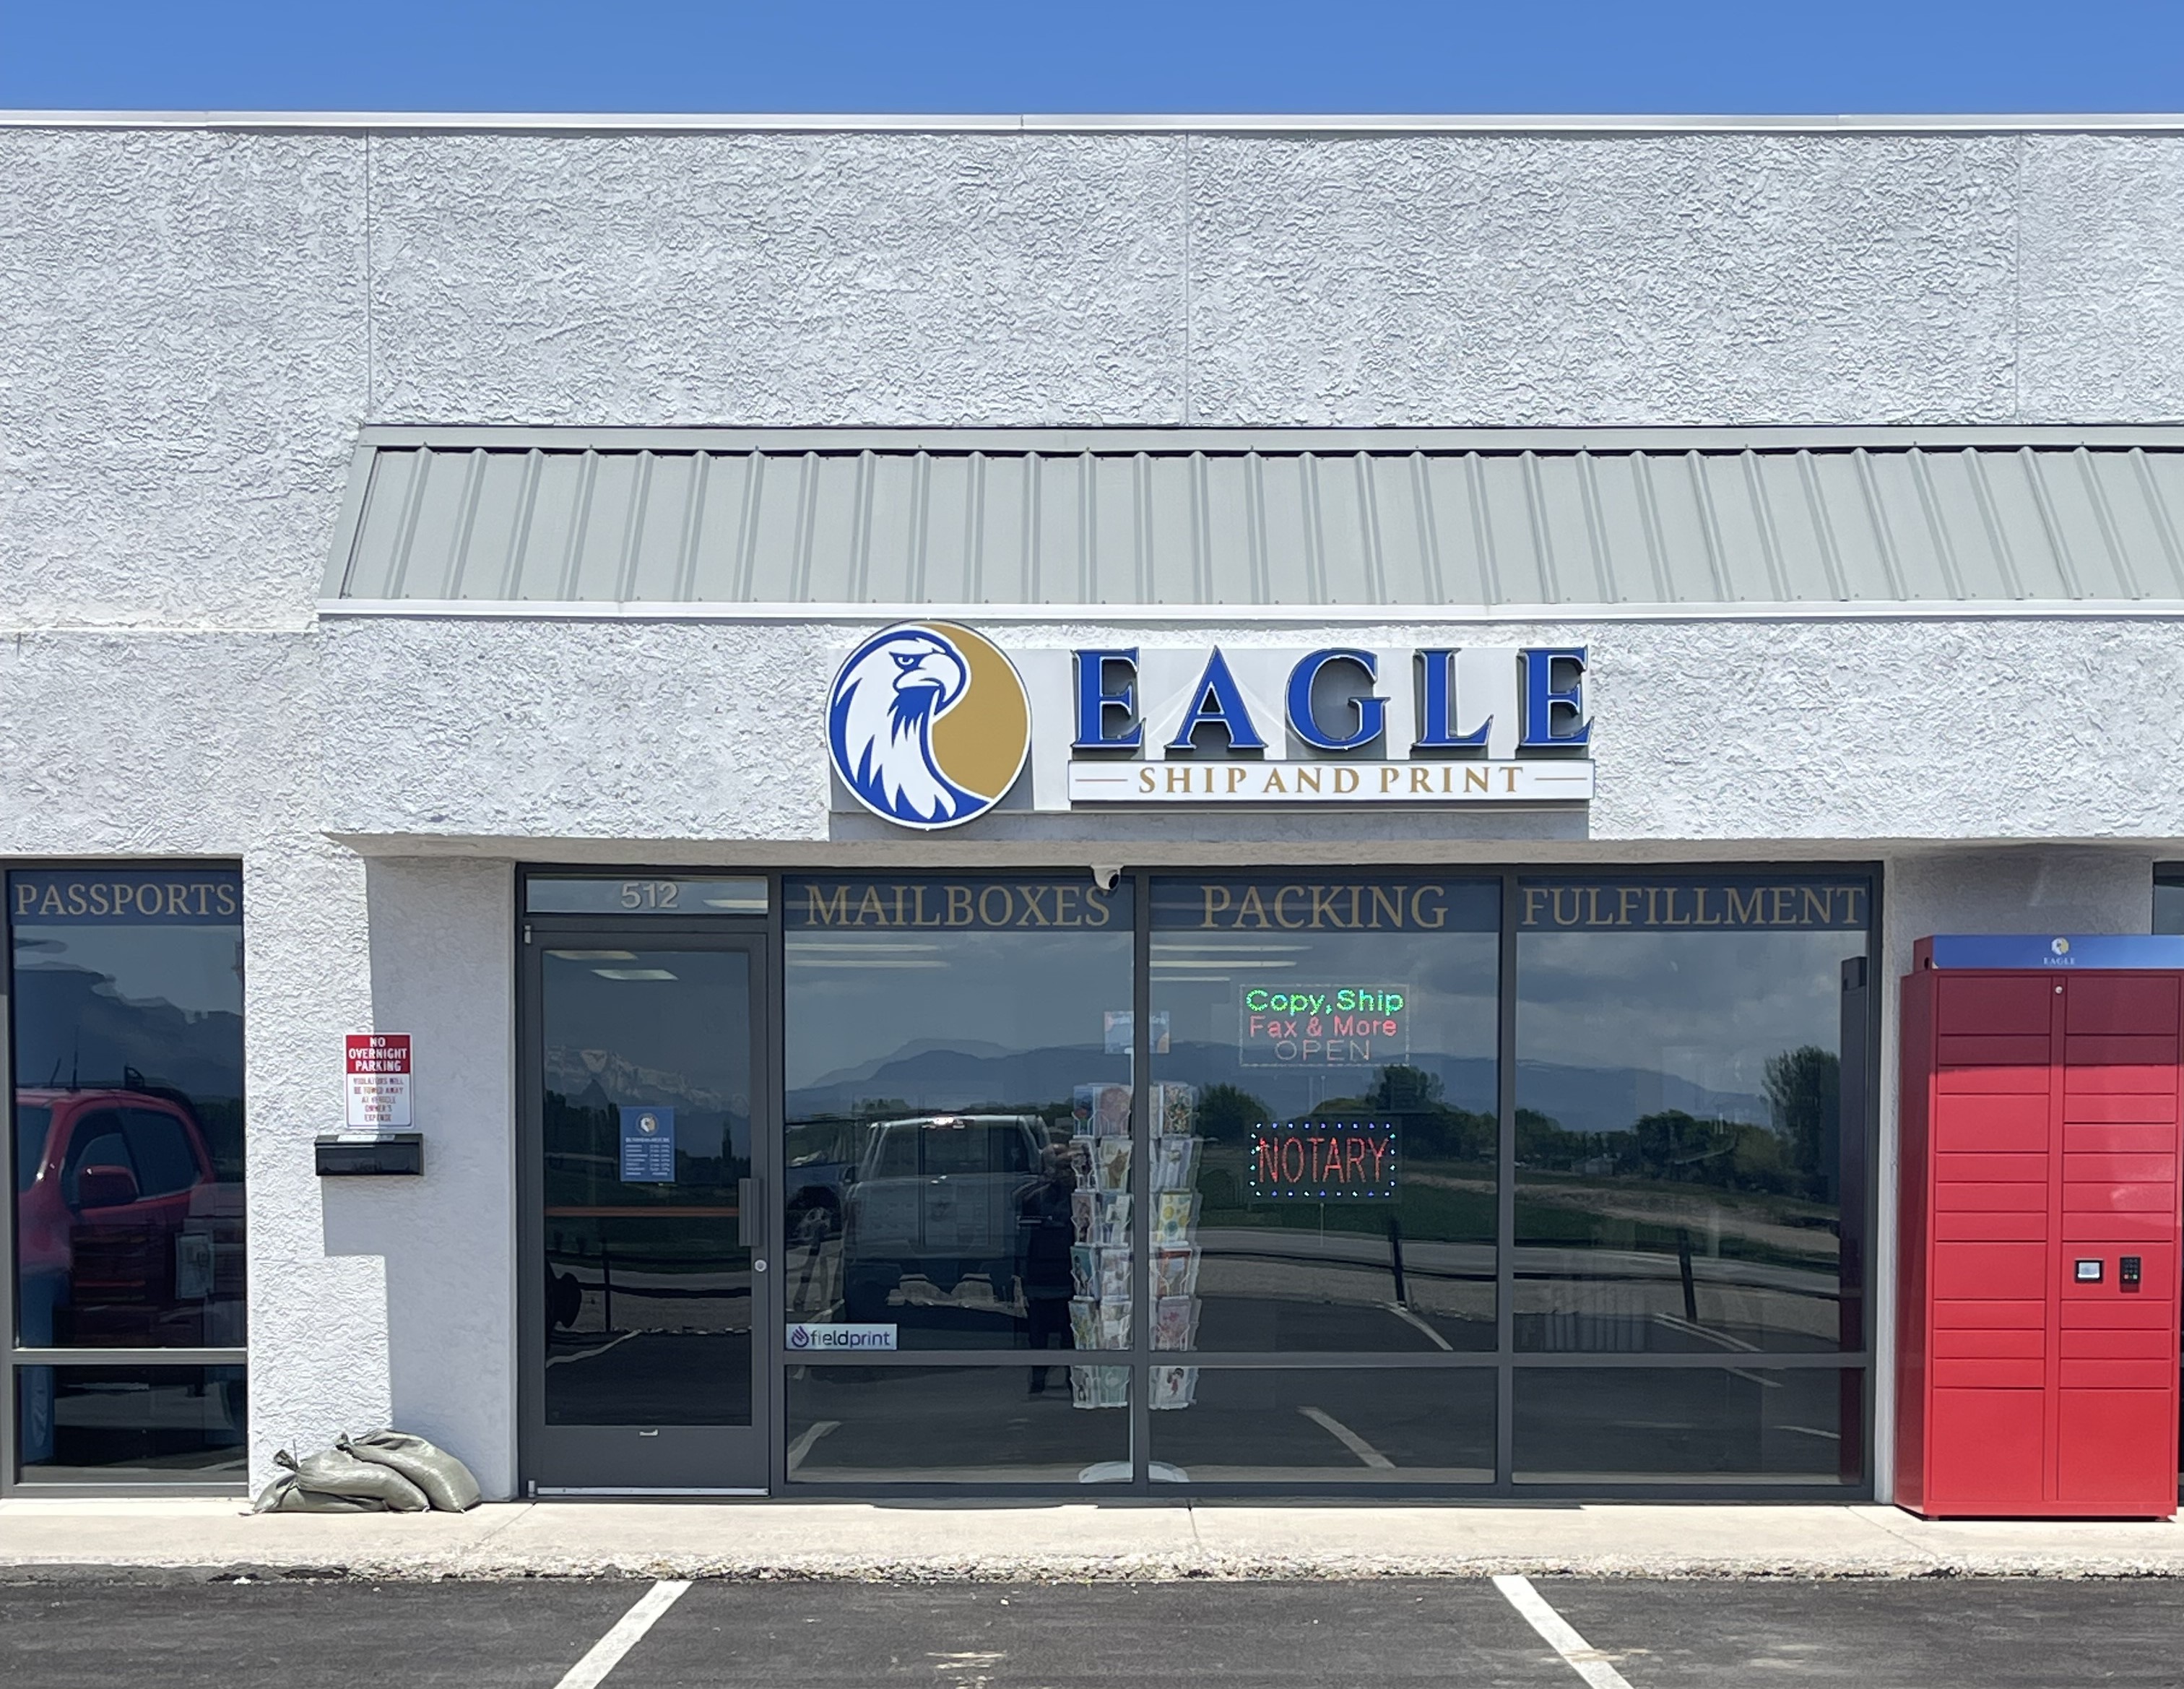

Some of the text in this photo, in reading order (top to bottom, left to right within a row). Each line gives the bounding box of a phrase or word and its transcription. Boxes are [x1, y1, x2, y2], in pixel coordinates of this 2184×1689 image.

[1071, 646, 1593, 751] EAGLE
[1139, 766, 1525, 795] SHIP AND PRINT
[14, 884, 237, 916] PASSPORTS
[620, 883, 680, 909] 512
[804, 886, 1111, 927] MAILBOXES
[1200, 885, 1449, 929] PACKING
[1522, 886, 1866, 927] FULFILLMENT
[1337, 989, 1404, 1016] Ship
[1249, 1014, 1398, 1038] Fax & More
[348, 1048, 407, 1060] OVERNIGHT
[370, 1037, 386, 1047] NO
[1275, 1039, 1370, 1061] OPEN
[355, 1061, 402, 1071] PARKING
[1258, 1137, 1389, 1183] NOTARY
[810, 1330, 890, 1348] fieldprint
